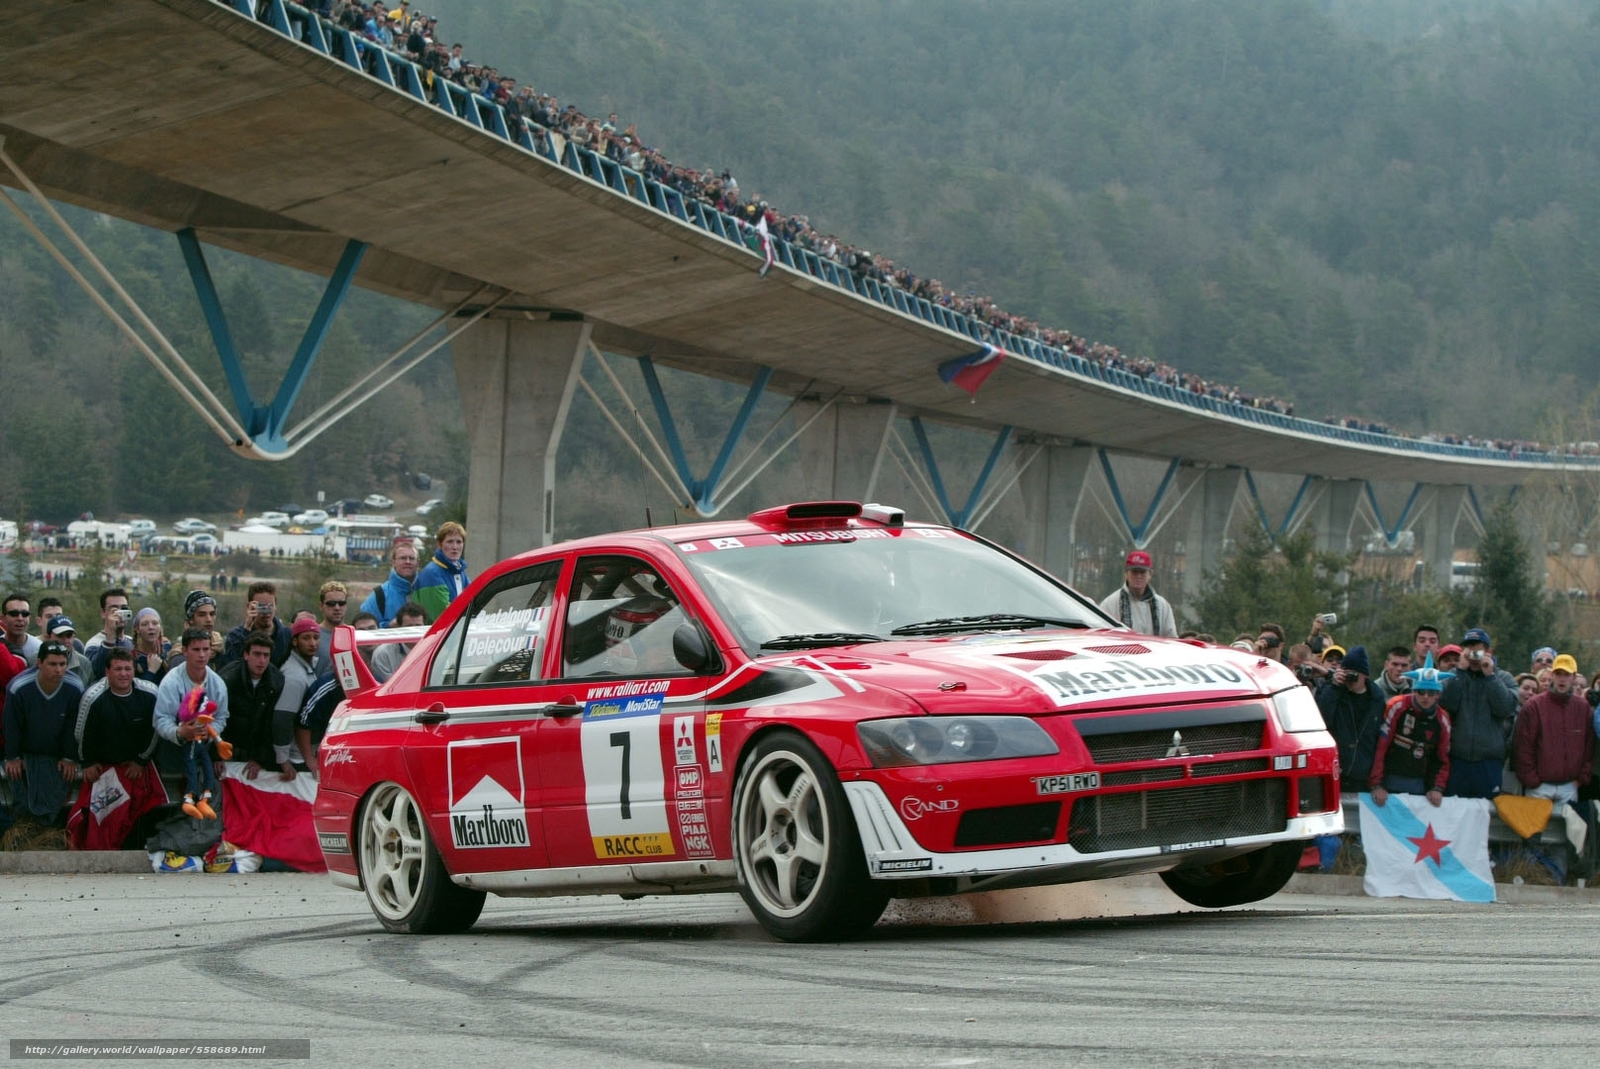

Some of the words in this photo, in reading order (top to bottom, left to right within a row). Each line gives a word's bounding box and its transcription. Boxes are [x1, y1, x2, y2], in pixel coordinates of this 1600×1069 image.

[772, 528, 892, 544] MITSUBISHI
[1034, 660, 1241, 698] Marlboro
[586, 680, 671, 699] www.ralliart.com
[624, 698, 661, 713] MoviStar
[710, 739, 720, 764] A
[609, 731, 632, 820] 7
[452, 804, 526, 846] Marlboro
[681, 824, 707, 835] PIAA
[603, 836, 644, 856] RACC
[645, 845, 663, 855] CLUB
[685, 835, 710, 850] NGK
[881, 859, 931, 870] MICHELIN
